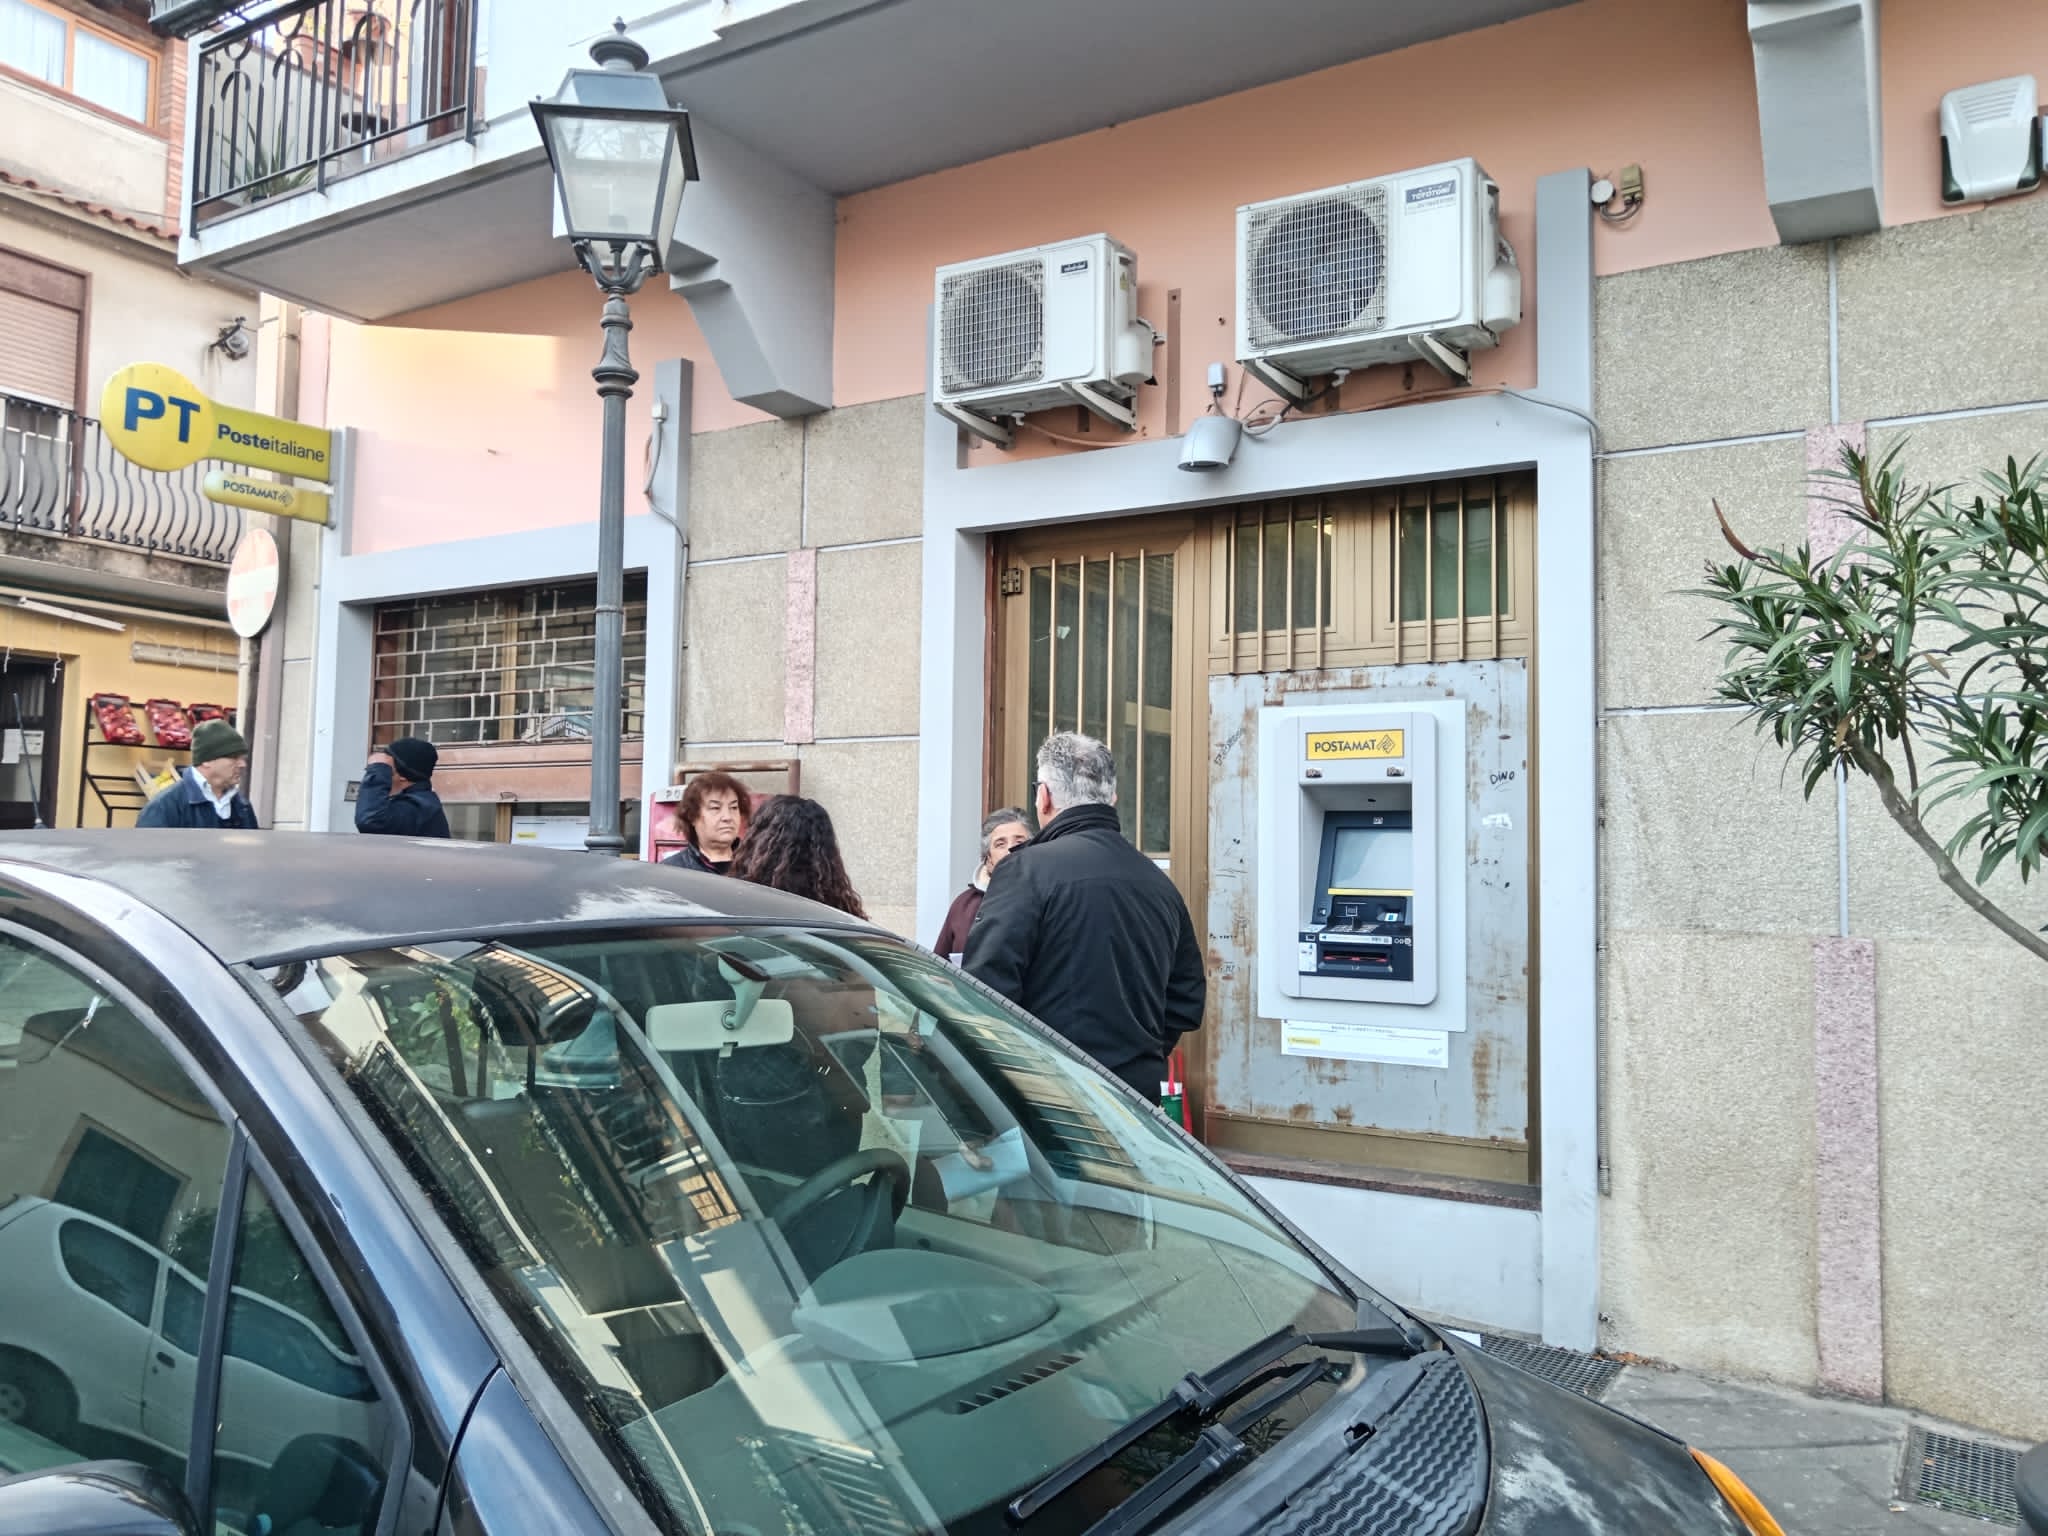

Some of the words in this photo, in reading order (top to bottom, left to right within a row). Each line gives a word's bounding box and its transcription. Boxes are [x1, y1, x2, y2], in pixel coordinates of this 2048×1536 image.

[124, 387, 200, 443] PT
[223, 480, 279, 501] POSTAMAT
[1314, 739, 1377, 753] POSTAMAT
